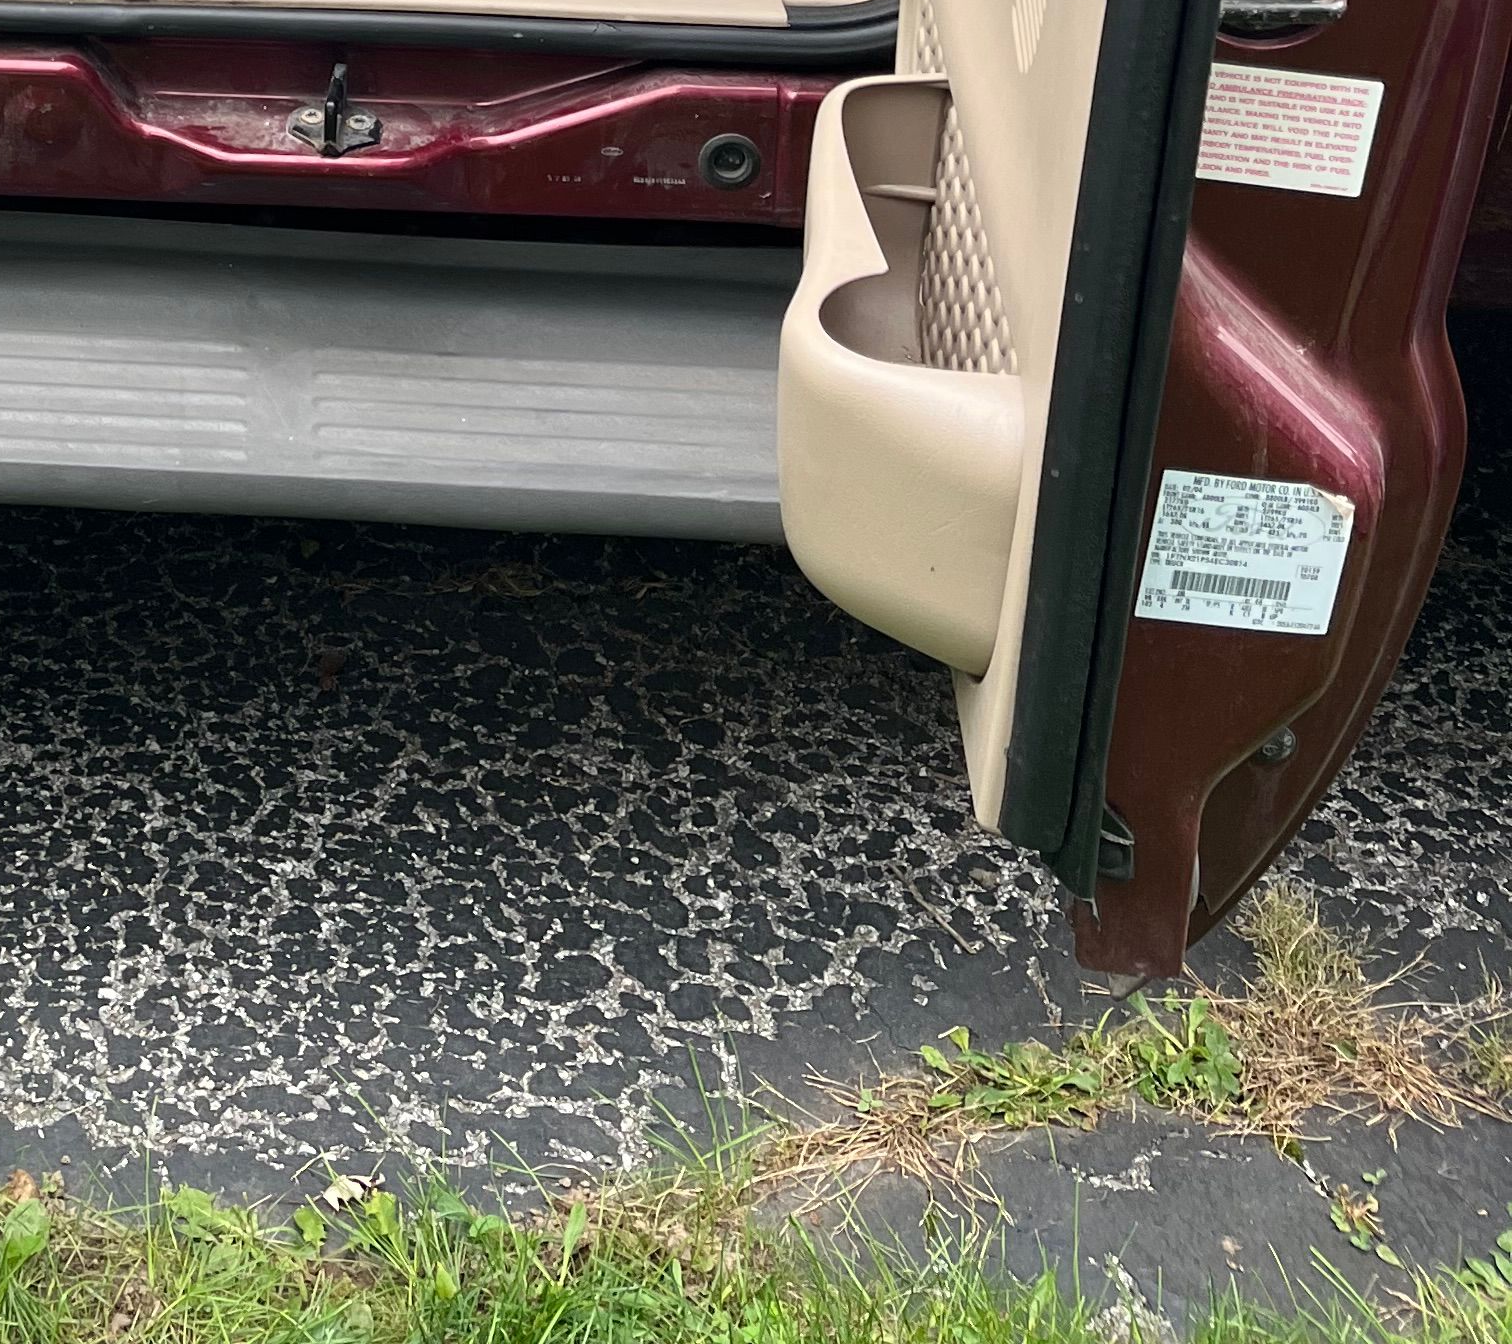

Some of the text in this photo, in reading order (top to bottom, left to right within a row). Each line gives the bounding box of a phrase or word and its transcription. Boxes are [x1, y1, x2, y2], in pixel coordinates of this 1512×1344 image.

[1215, 71, 1250, 82] VEHICLE
[1214, 479, 1224, 488] BY
[1226, 480, 1247, 490] FORD
[1249, 483, 1276, 493] MOTOR
[1293, 487, 1302, 496] IN
